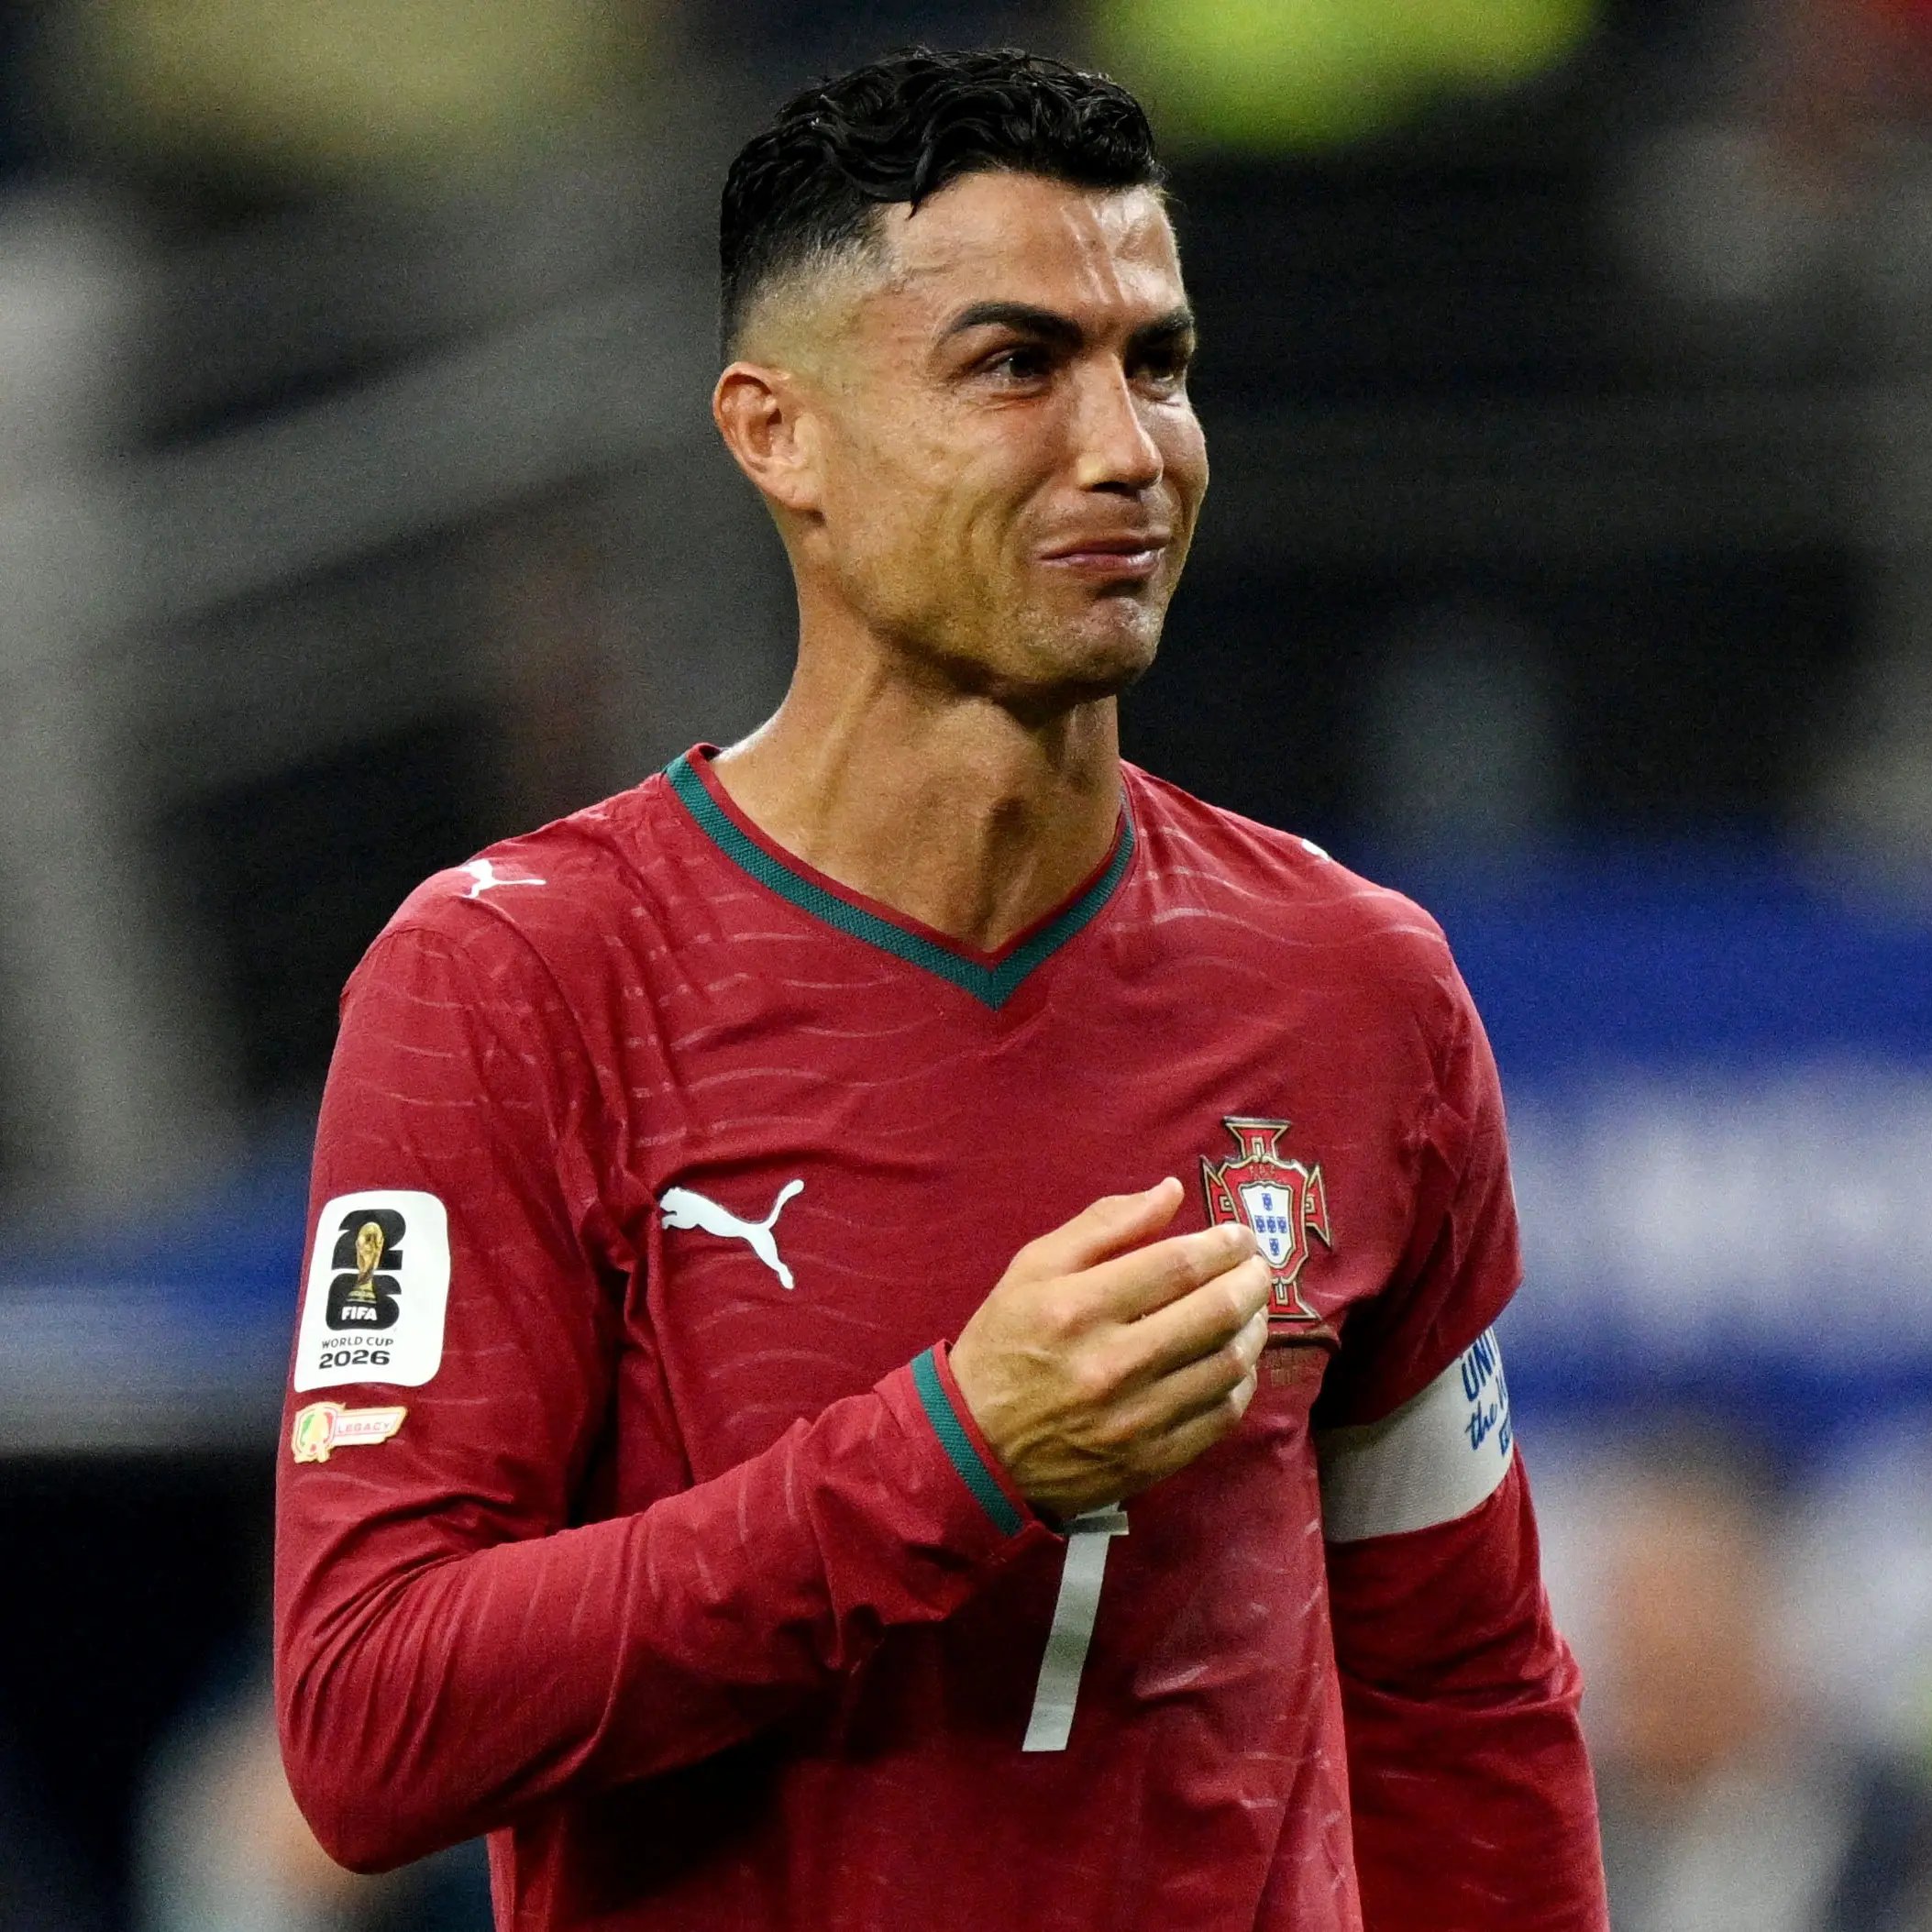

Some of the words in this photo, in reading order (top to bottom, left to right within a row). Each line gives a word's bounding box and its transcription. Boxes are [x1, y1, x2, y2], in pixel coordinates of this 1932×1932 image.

[332, 1209, 406, 1270] 2
[326, 1273, 402, 1330] 6
[341, 1306, 378, 1321] FIFA
[322, 1336, 363, 1349] WORLD
[367, 1336, 394, 1347] CUP
[319, 1350, 391, 1369] 2026
[337, 1421, 391, 1434] LEGACY
